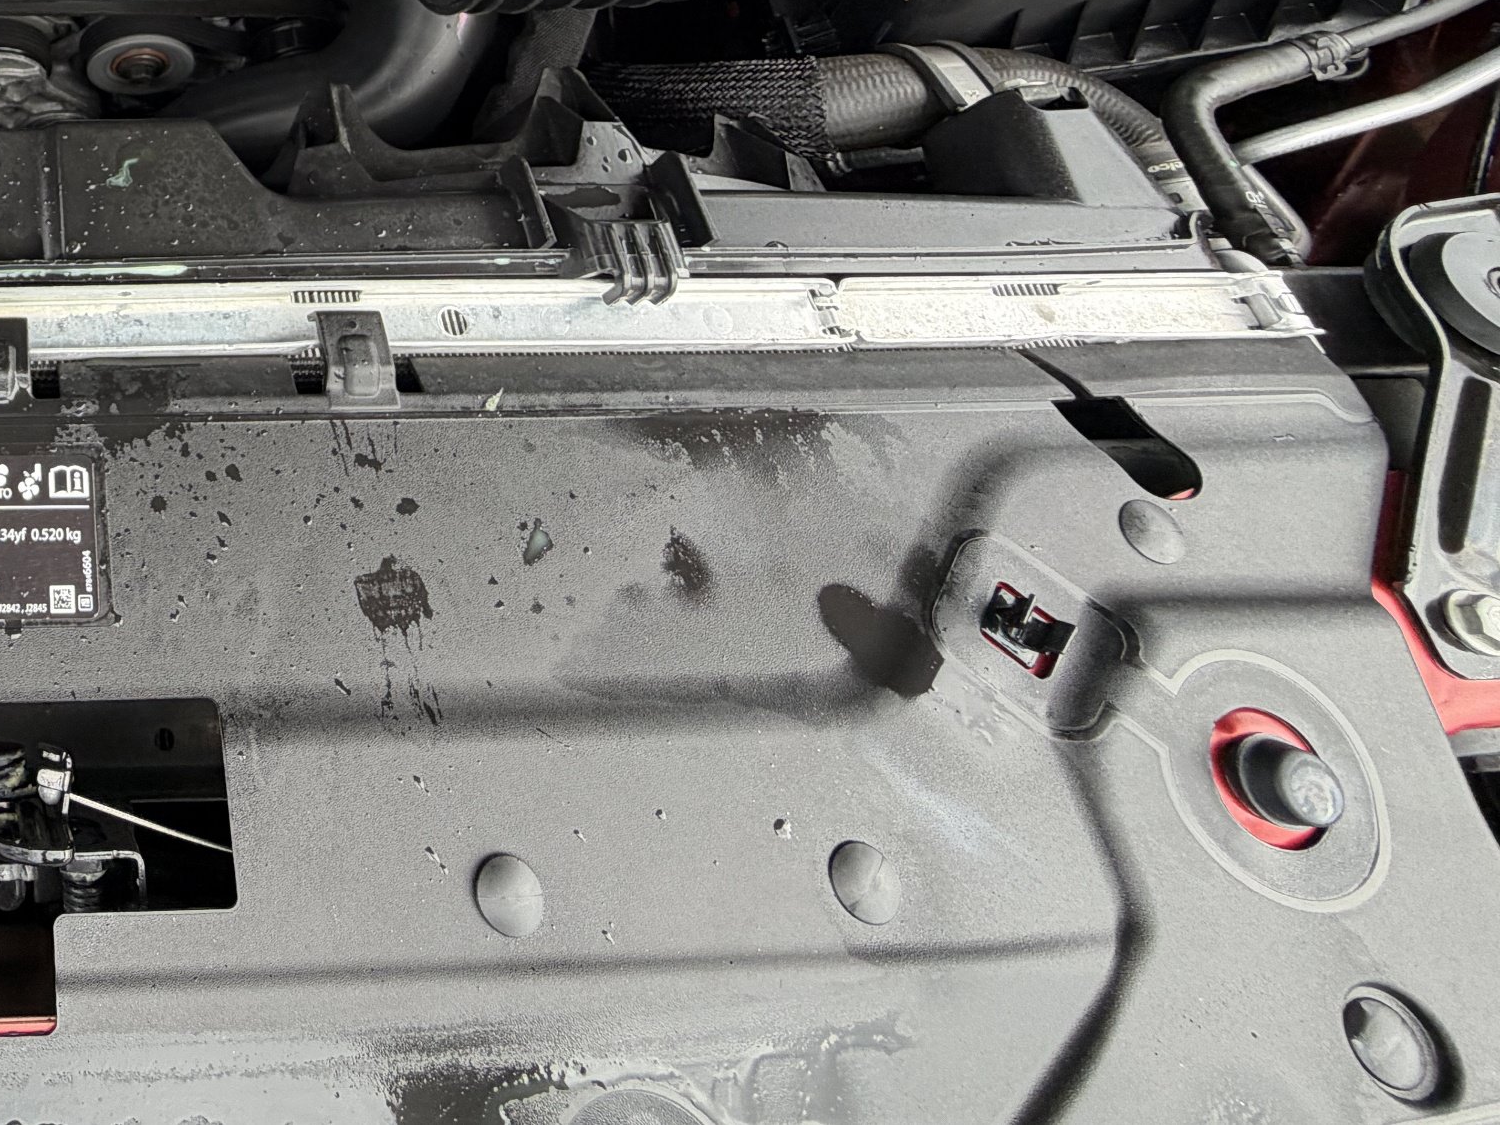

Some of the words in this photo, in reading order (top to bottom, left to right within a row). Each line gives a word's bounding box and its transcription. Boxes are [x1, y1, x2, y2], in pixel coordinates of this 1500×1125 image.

[1148, 161, 1184, 172] elco
[31, 528, 64, 541] 0.520
[66, 528, 82, 544] kg
[25, 604, 47, 614] J2845
